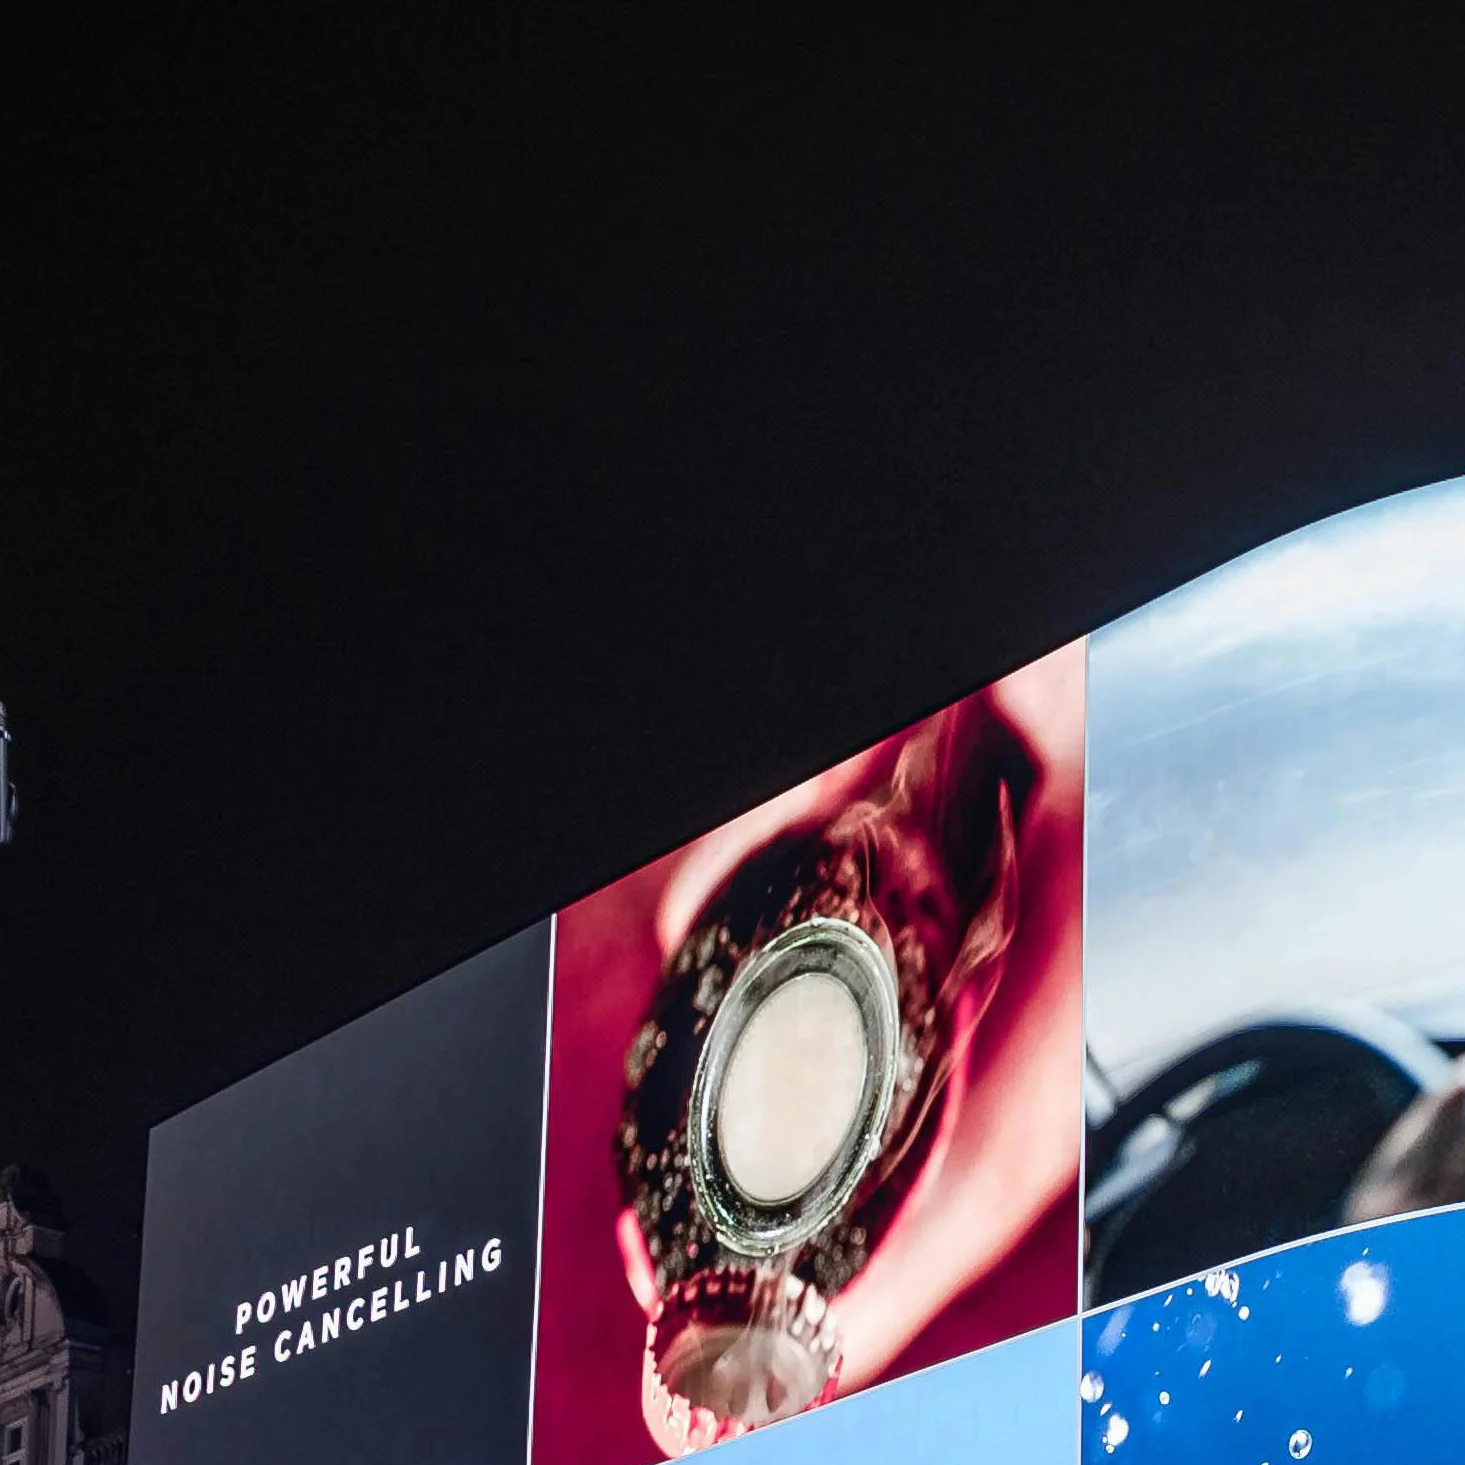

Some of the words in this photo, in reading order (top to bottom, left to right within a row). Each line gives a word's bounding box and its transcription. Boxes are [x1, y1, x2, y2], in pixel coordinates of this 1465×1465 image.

[160, 1345, 257, 1415] NOISE
[274, 1237, 502, 1363] CANCELLING
[235, 1226, 421, 1335] POWERFUL
